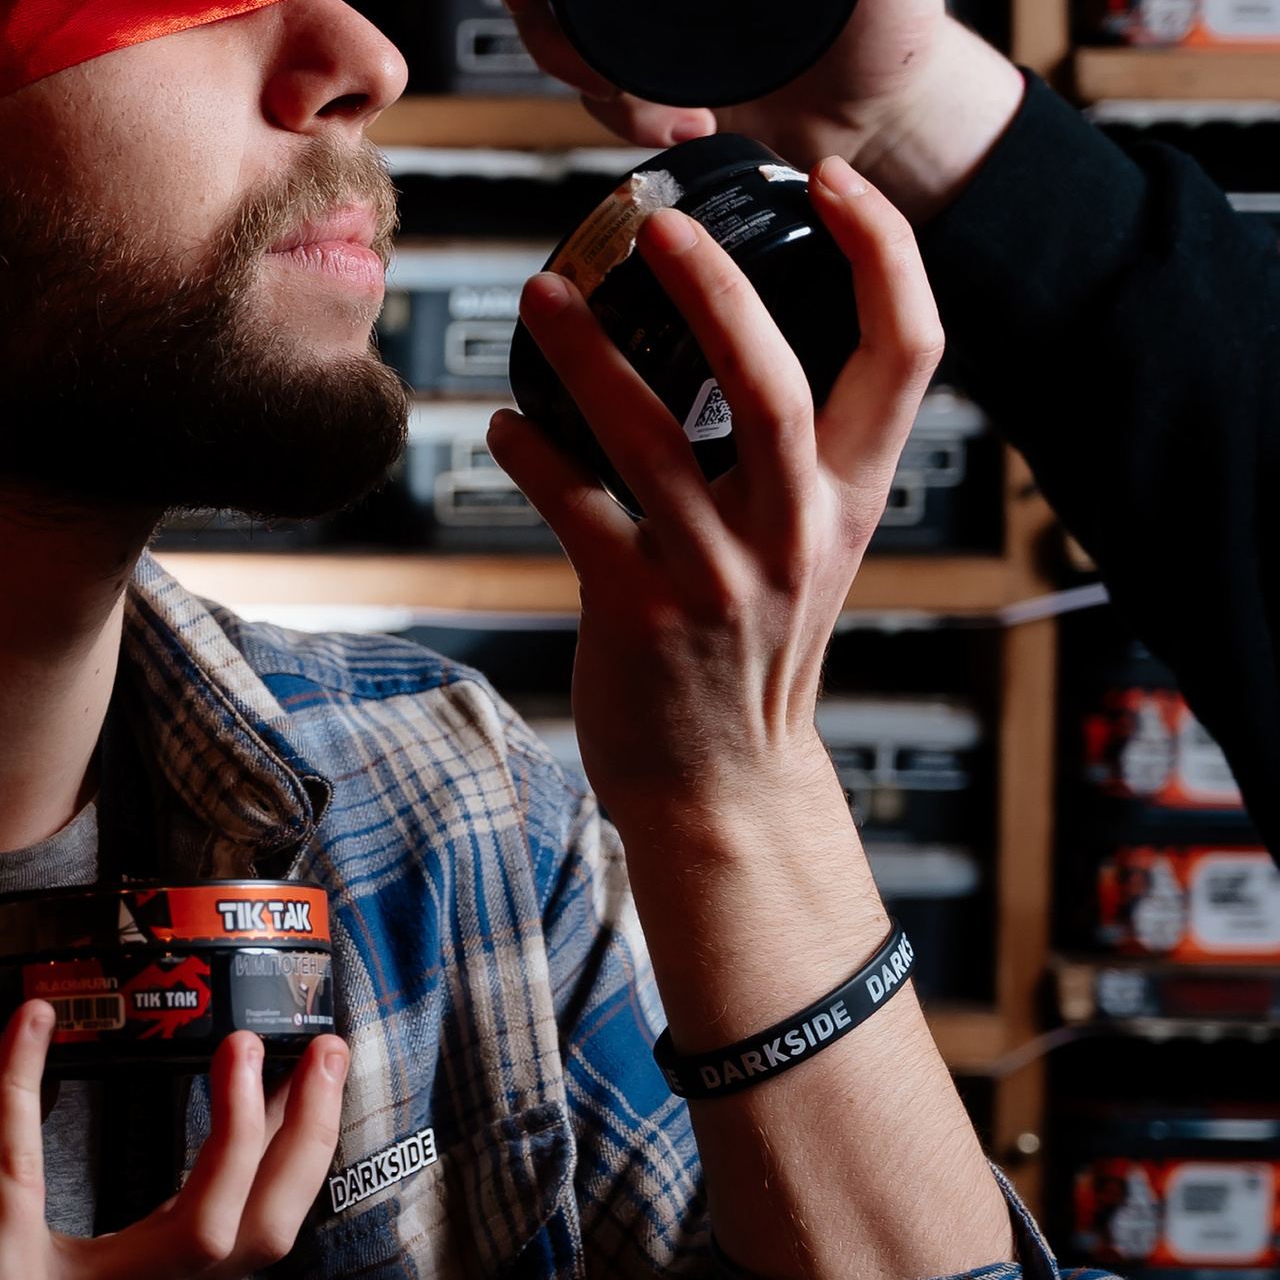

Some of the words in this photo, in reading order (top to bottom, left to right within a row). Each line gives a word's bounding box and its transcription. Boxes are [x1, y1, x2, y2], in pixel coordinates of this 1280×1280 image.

[584, 211, 633, 264] СПЕЦИАЛЬНАЯ
[218, 901, 267, 932] TIK
[267, 901, 312, 932] TAK
[135, 992, 161, 1008] TIK
[165, 990, 198, 1008] TAK
[699, 1000, 852, 1090] DARKSIDE
[331, 1131, 436, 1210] DARKSIDE
